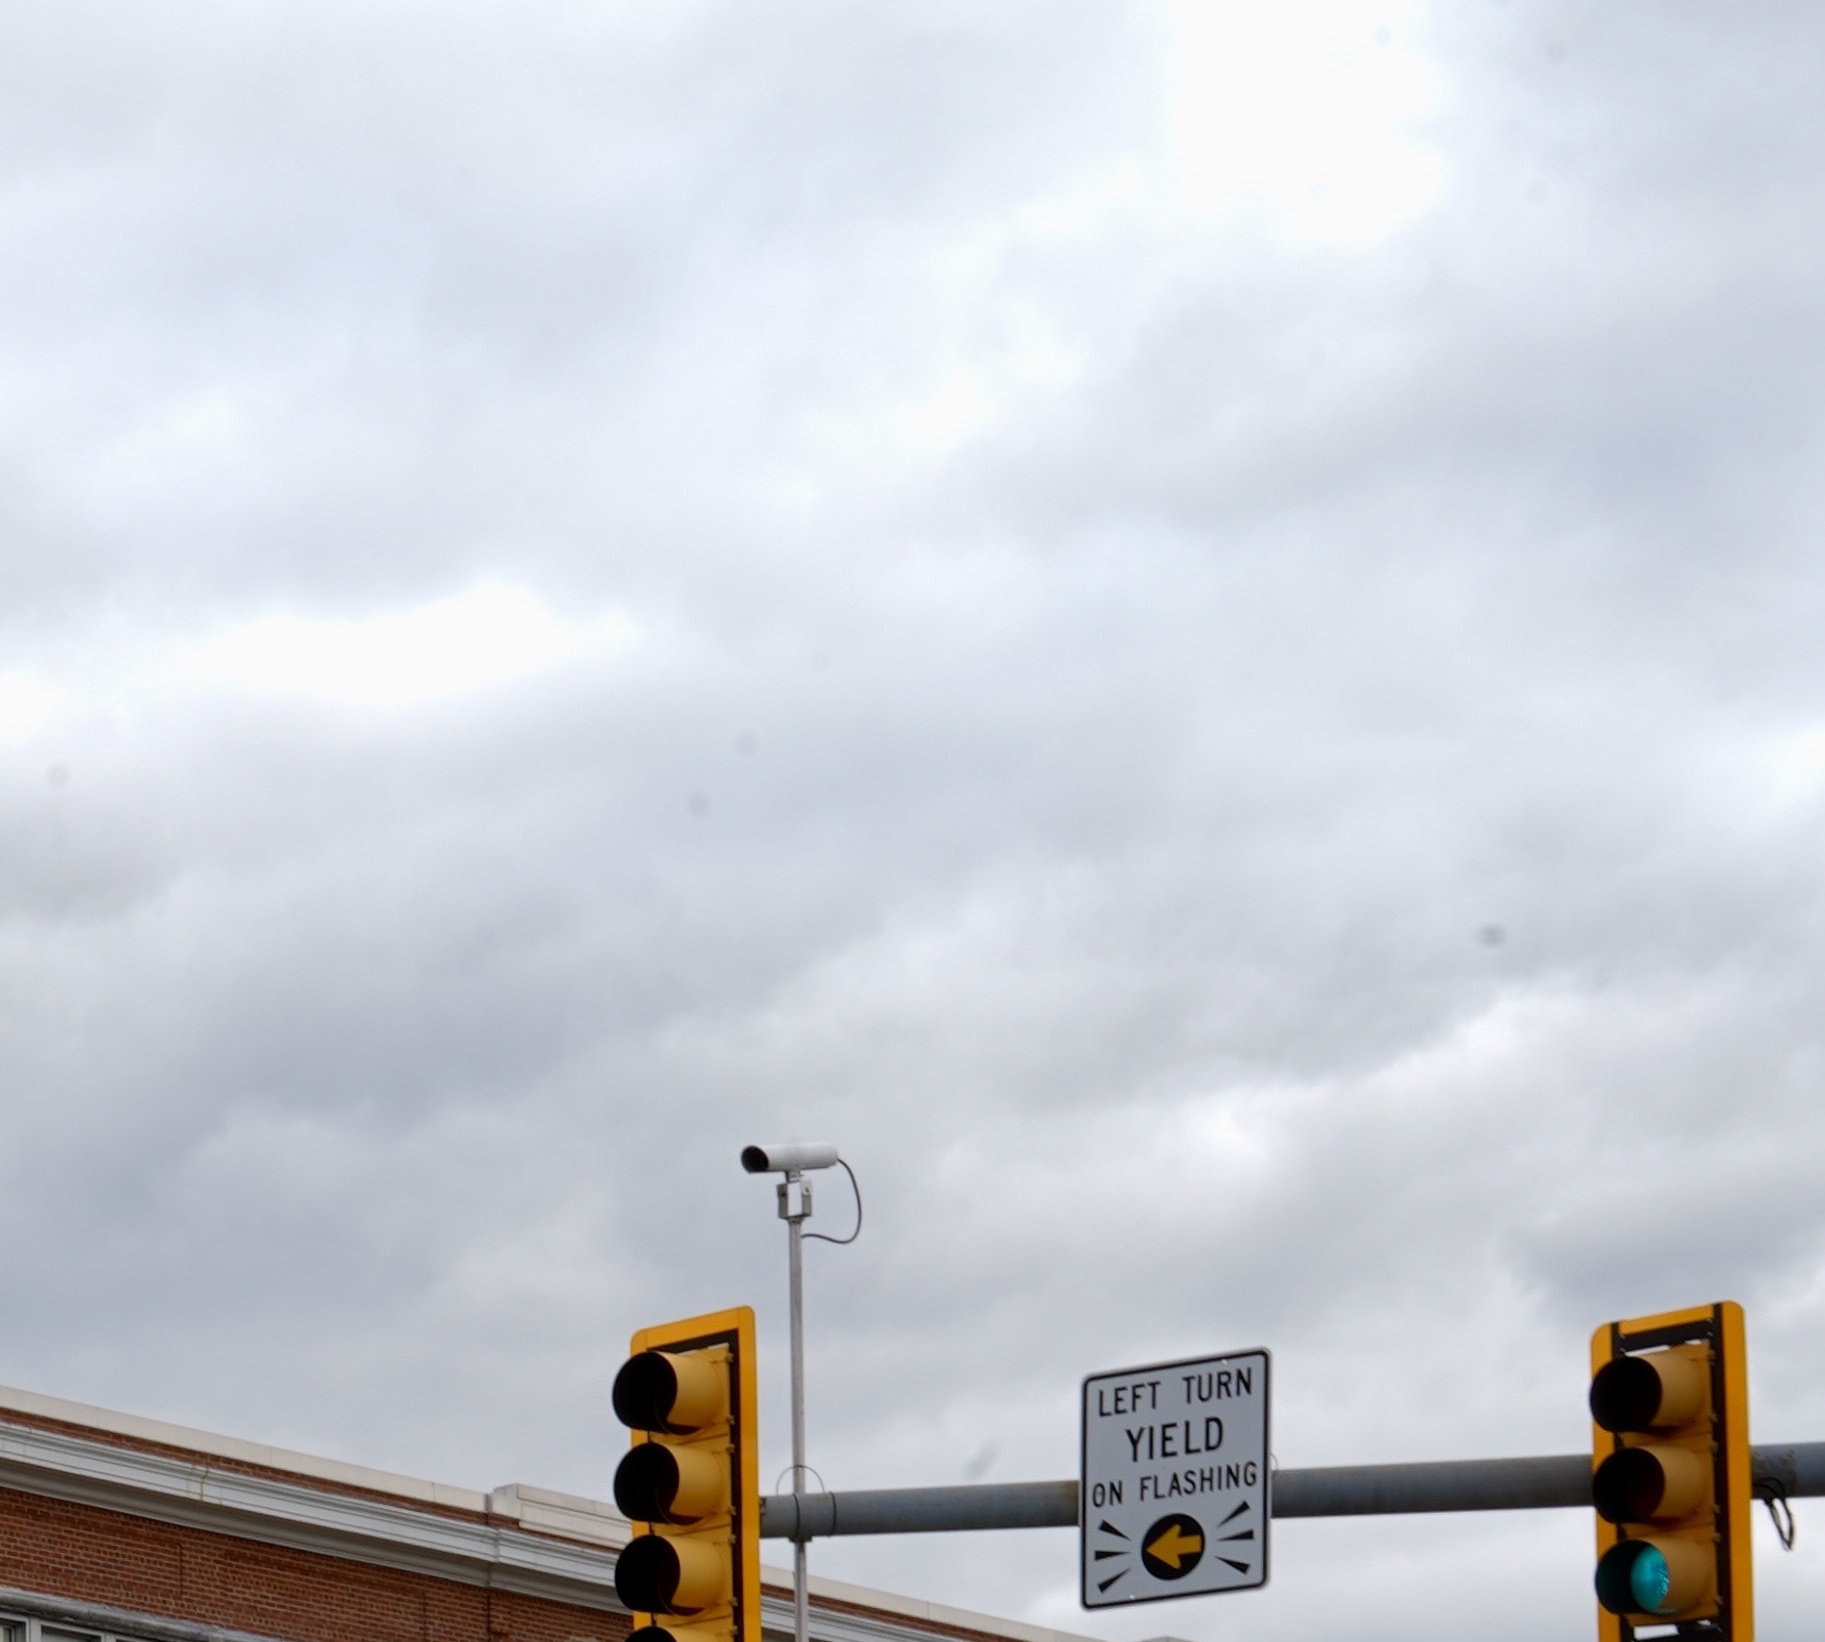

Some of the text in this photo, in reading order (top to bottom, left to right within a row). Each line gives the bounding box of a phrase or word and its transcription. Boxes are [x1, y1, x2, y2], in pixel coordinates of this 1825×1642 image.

[1098, 1367, 1253, 1418] LEFT TURN
[1125, 1416, 1224, 1463] YIELD
[1092, 1461, 1258, 1508] ON FLASHING
